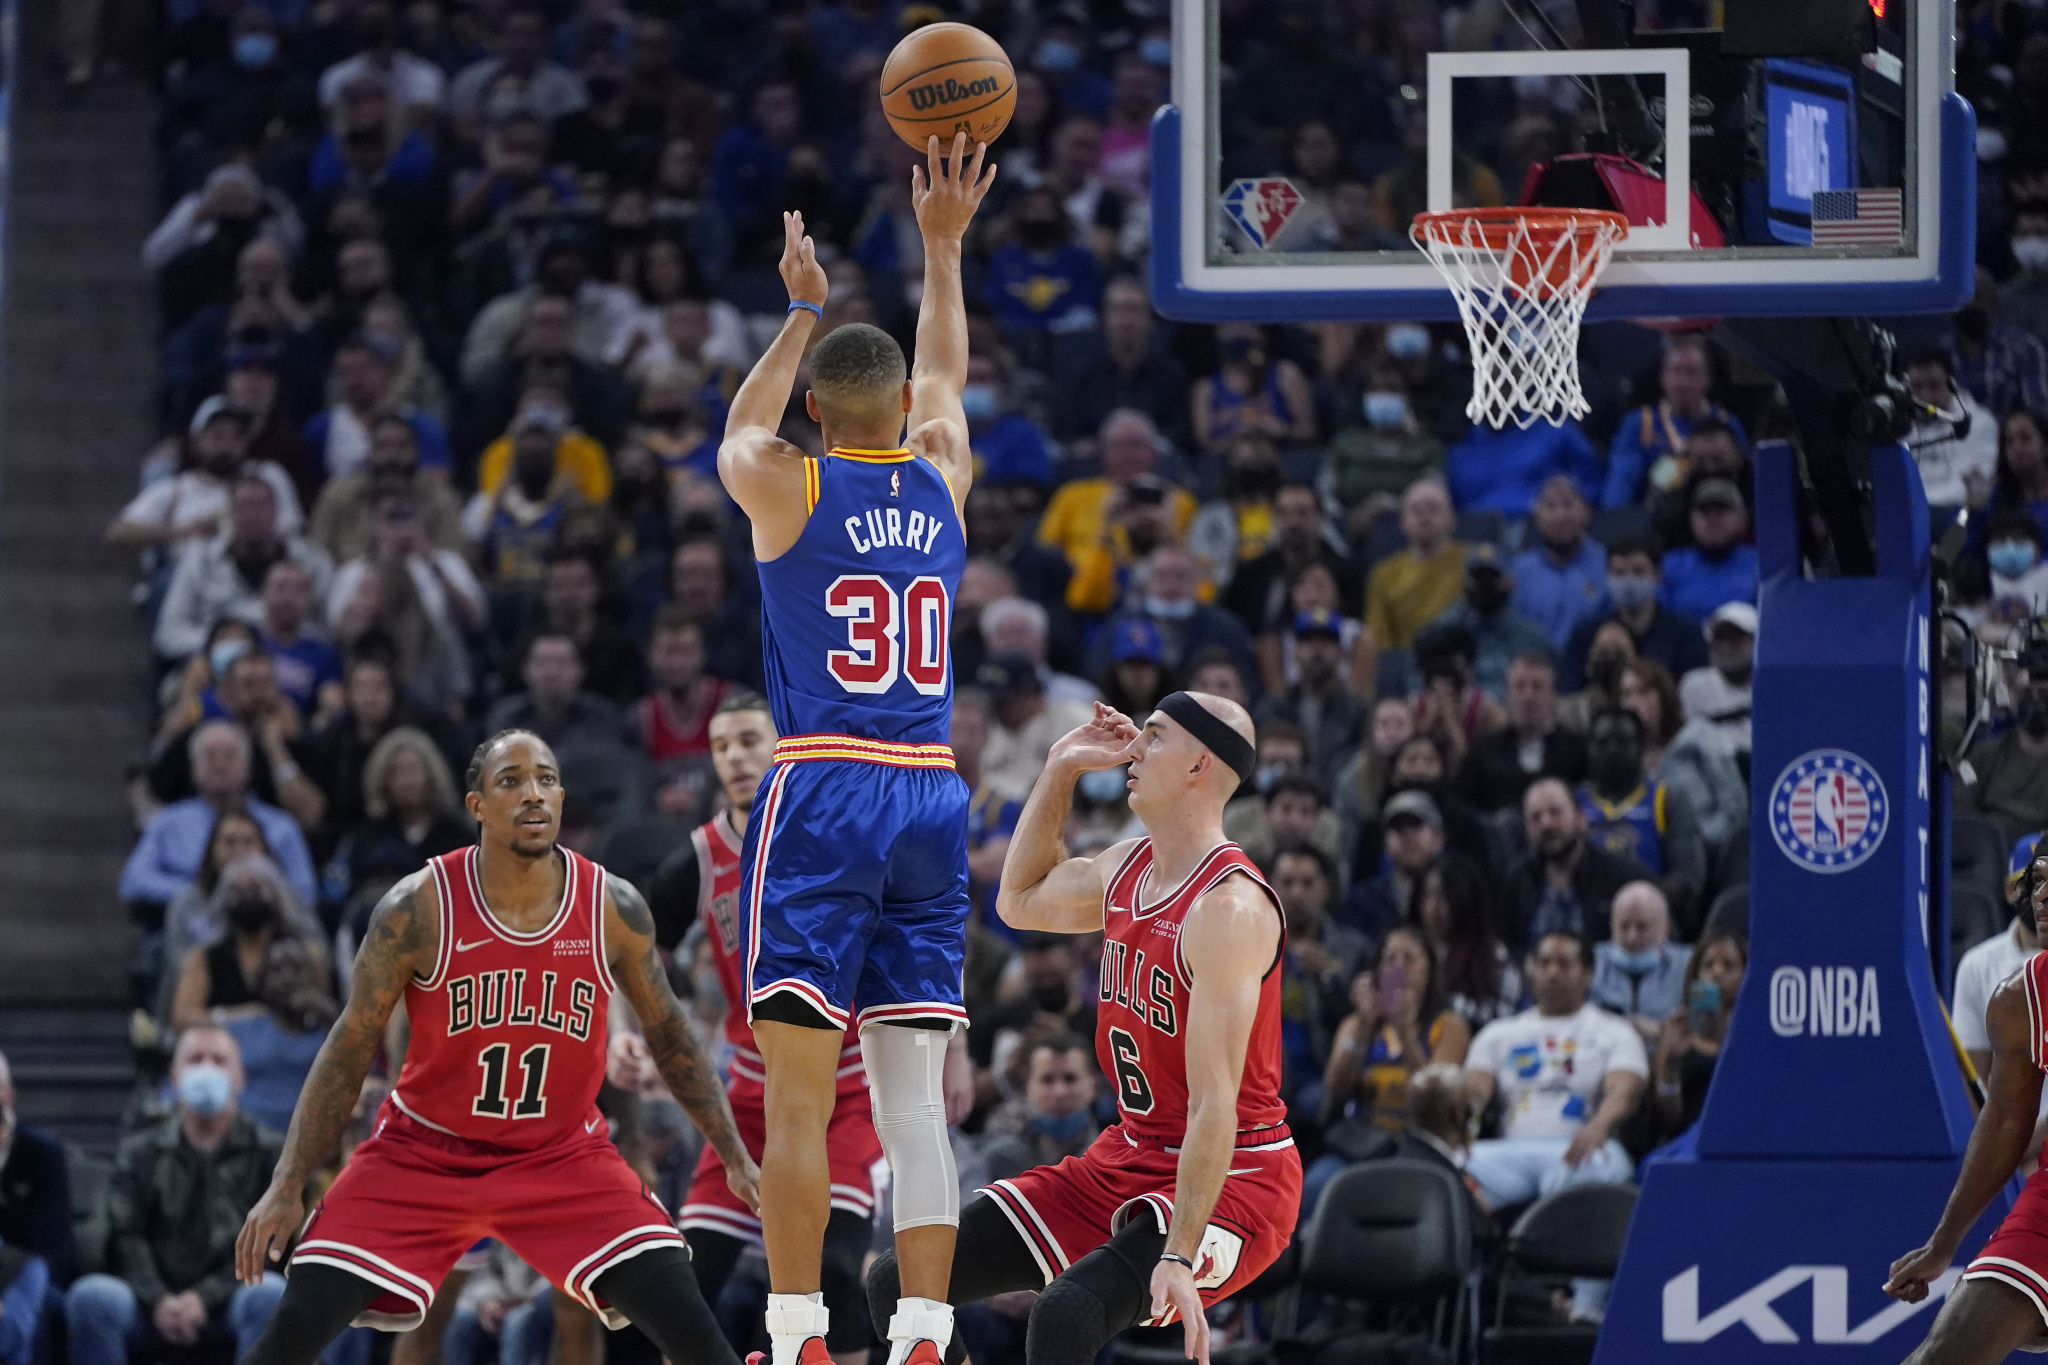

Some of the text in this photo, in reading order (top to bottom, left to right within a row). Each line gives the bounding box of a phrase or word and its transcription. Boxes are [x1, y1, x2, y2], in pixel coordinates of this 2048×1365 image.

[907, 76, 999, 111] Wilson
[844, 508, 943, 555] CURRY
[825, 574, 950, 696] 30
[1918, 614, 1930, 801] NBA
[553, 939, 590, 950] ZENNI
[447, 968, 596, 1042] BULLS
[1100, 939, 1178, 1037] ULLS
[1769, 965, 1882, 1037] @NBA
[472, 1042, 551, 1120] 11
[1109, 1026, 1155, 1116] 6
